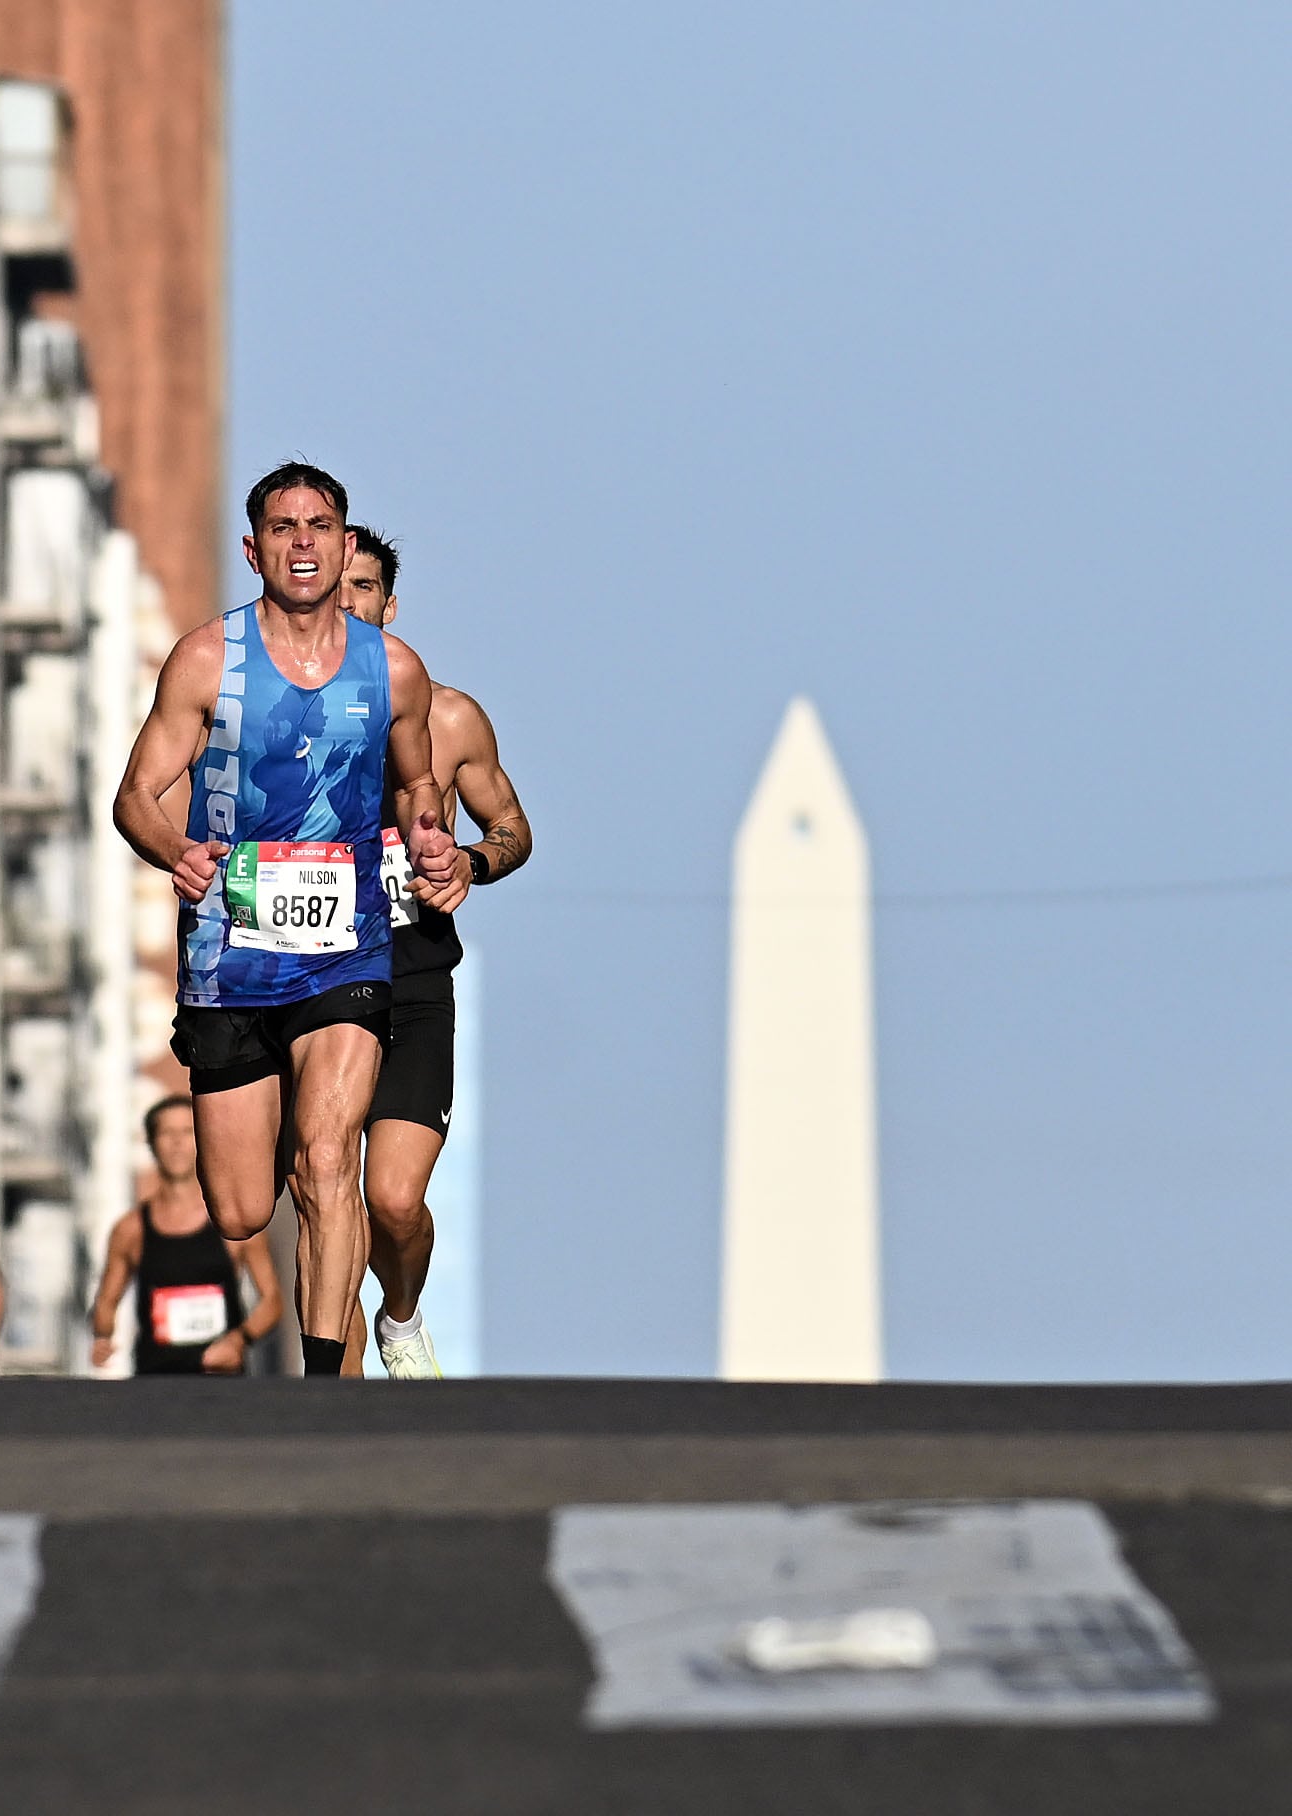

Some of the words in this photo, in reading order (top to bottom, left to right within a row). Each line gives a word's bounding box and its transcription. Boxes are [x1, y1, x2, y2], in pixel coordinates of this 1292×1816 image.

[290, 848, 326, 858] personal
[236, 854, 249, 877] E
[299, 870, 337, 885] NILSON
[272, 895, 339, 928] 8587
